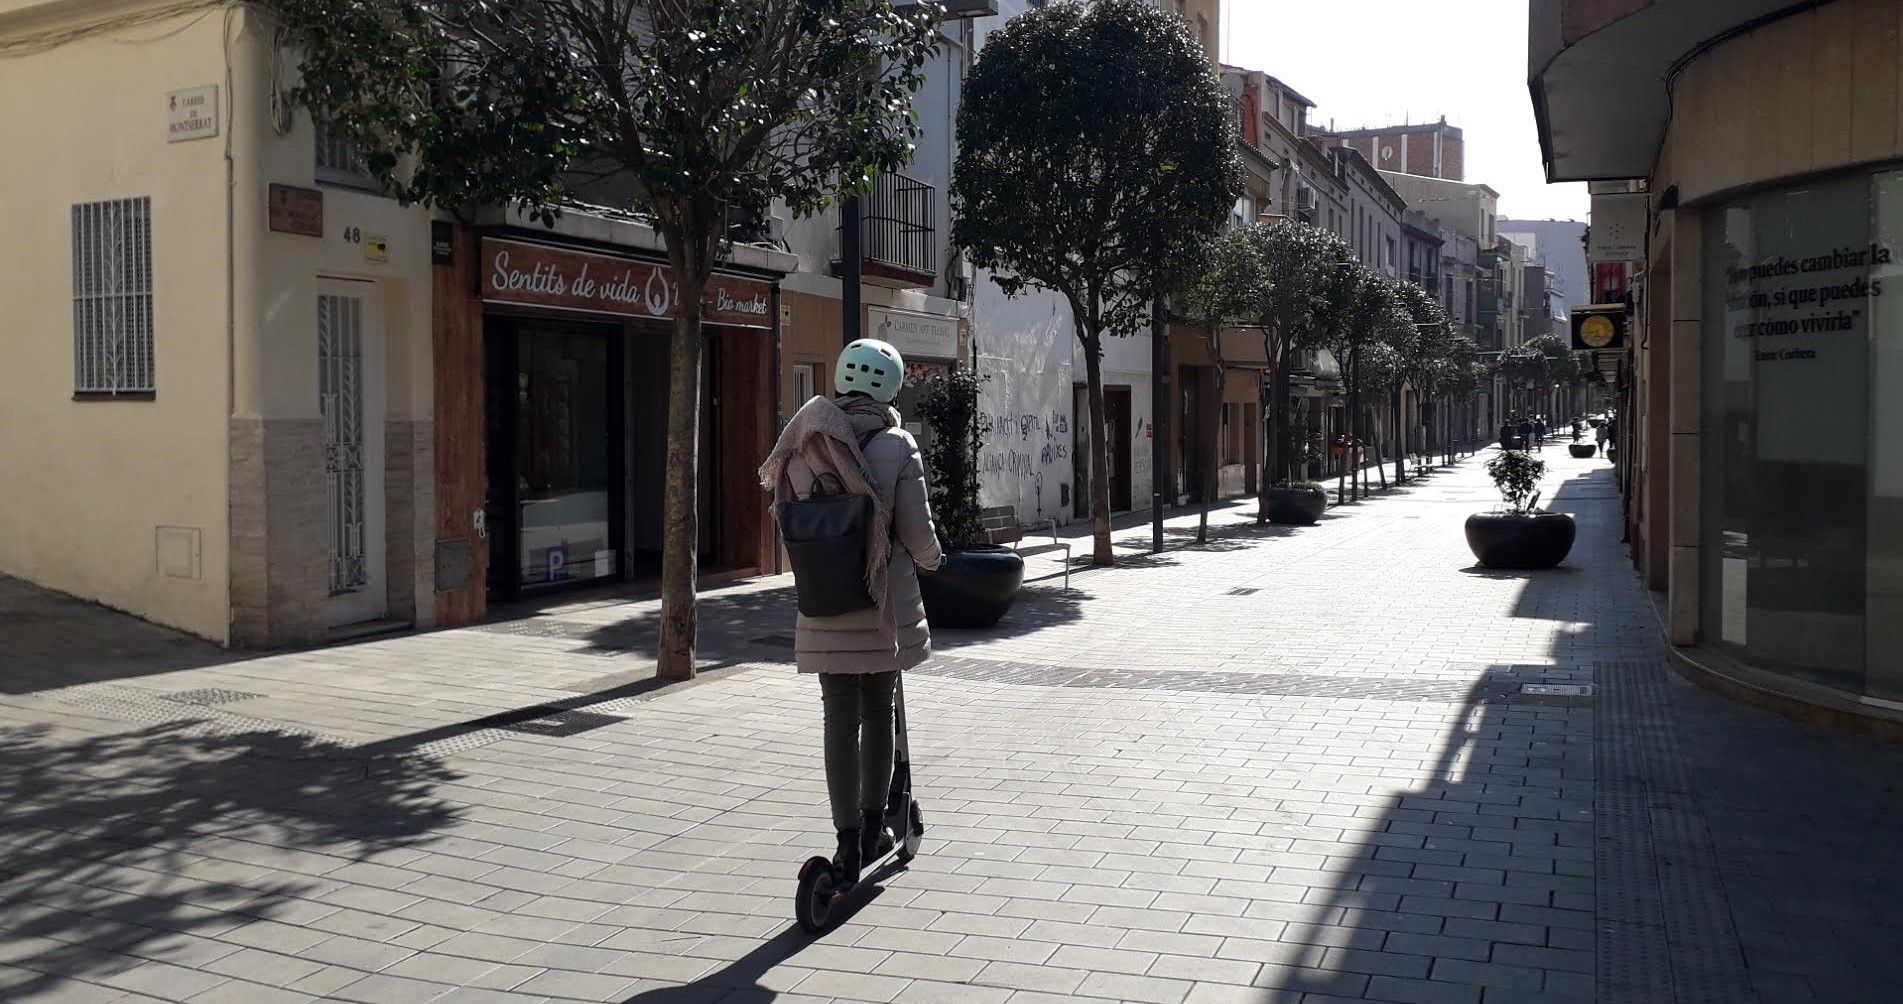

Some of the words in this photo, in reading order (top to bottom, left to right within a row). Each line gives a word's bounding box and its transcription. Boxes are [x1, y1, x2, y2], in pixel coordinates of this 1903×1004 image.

[169, 117, 213, 132] MONTSERRAT
[343, 226, 361, 243] 48
[1750, 256, 1799, 280] puedes
[1800, 247, 1867, 273] cambiar
[1869, 242, 1891, 266] la
[492, 251, 567, 297] Sentits
[571, 263, 596, 301] de
[600, 269, 640, 304] vida
[1788, 287, 1817, 309] que
[1819, 276, 1882, 307] puedes
[717, 287, 735, 311] Bio
[735, 292, 768, 315] market
